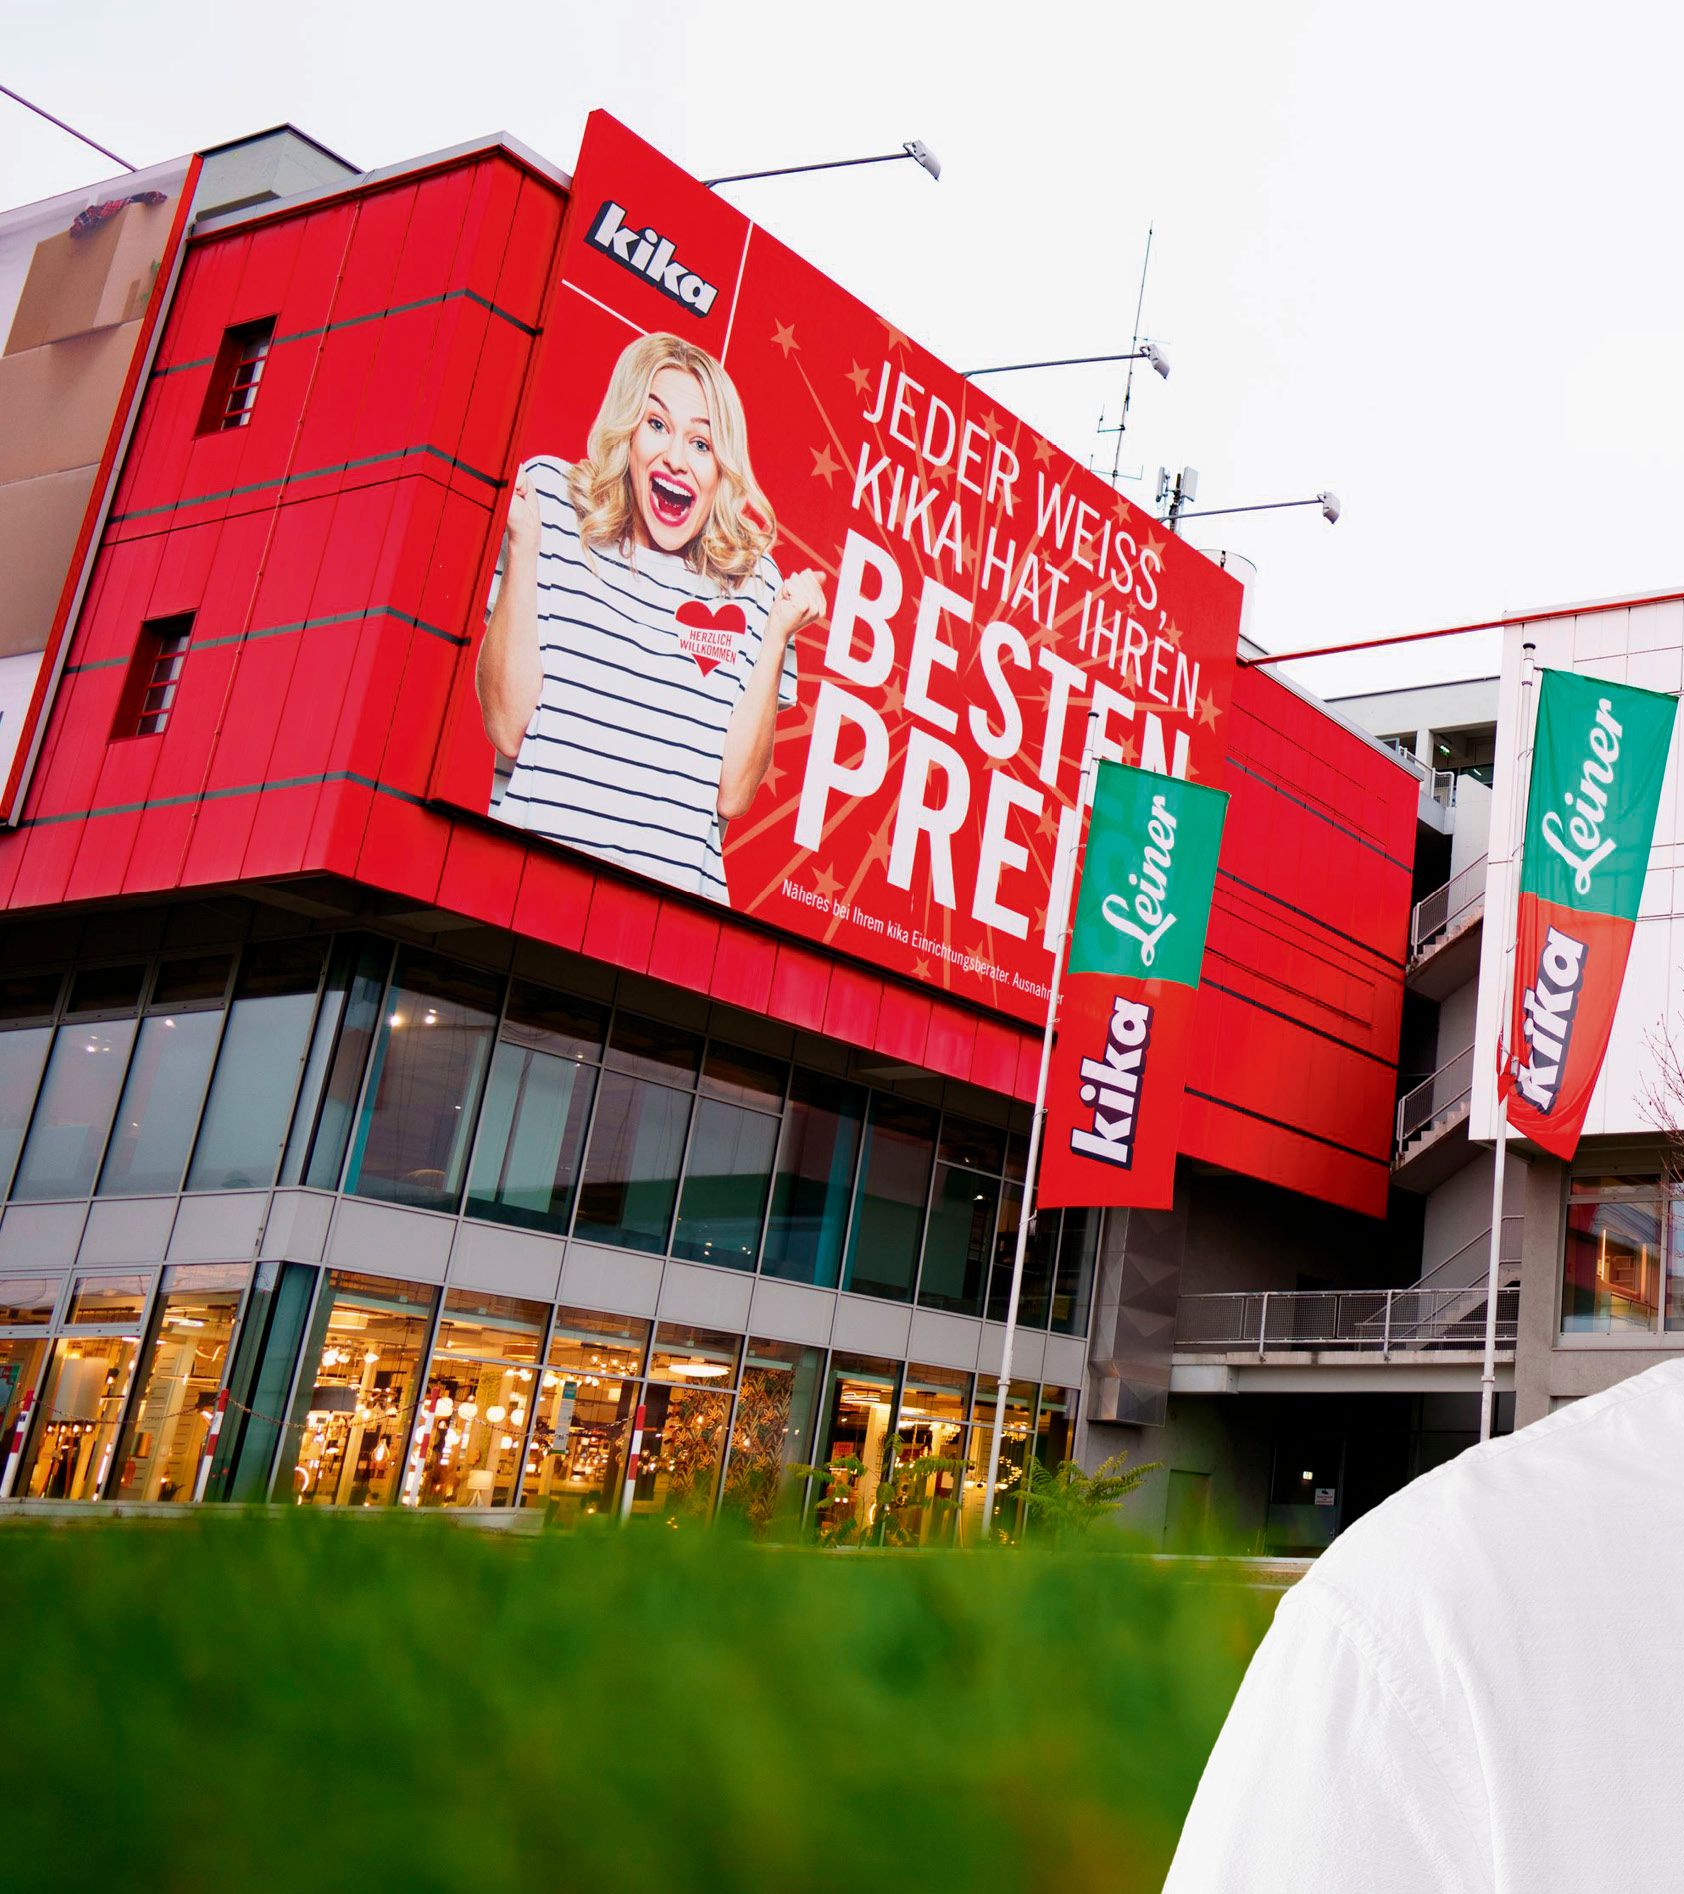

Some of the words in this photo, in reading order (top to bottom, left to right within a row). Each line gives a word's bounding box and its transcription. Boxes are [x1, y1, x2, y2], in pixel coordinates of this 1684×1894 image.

[586, 201, 719, 317] kika
[851, 442, 963, 575] KIKA
[981, 527, 1069, 631] HAT
[1078, 590, 1201, 720] IHREN
[863, 360, 1020, 518] JEDER
[1037, 471, 1167, 631] WEISS,
[680, 640, 736, 664] WILLKOMMEN
[690, 630, 732, 647] HERZLICH
[1101, 794, 1178, 966] Leiner
[1542, 697, 1623, 894] Leiner
[781, 878, 830, 913] Näheres
[832, 898, 850, 920] bei
[852, 906, 884, 935] Ihrem
[887, 922, 909, 944] kika
[911, 930, 1011, 985] Einrichtungsberater.
[1070, 995, 1154, 1171] kika
[1516, 925, 1588, 1115] kika
